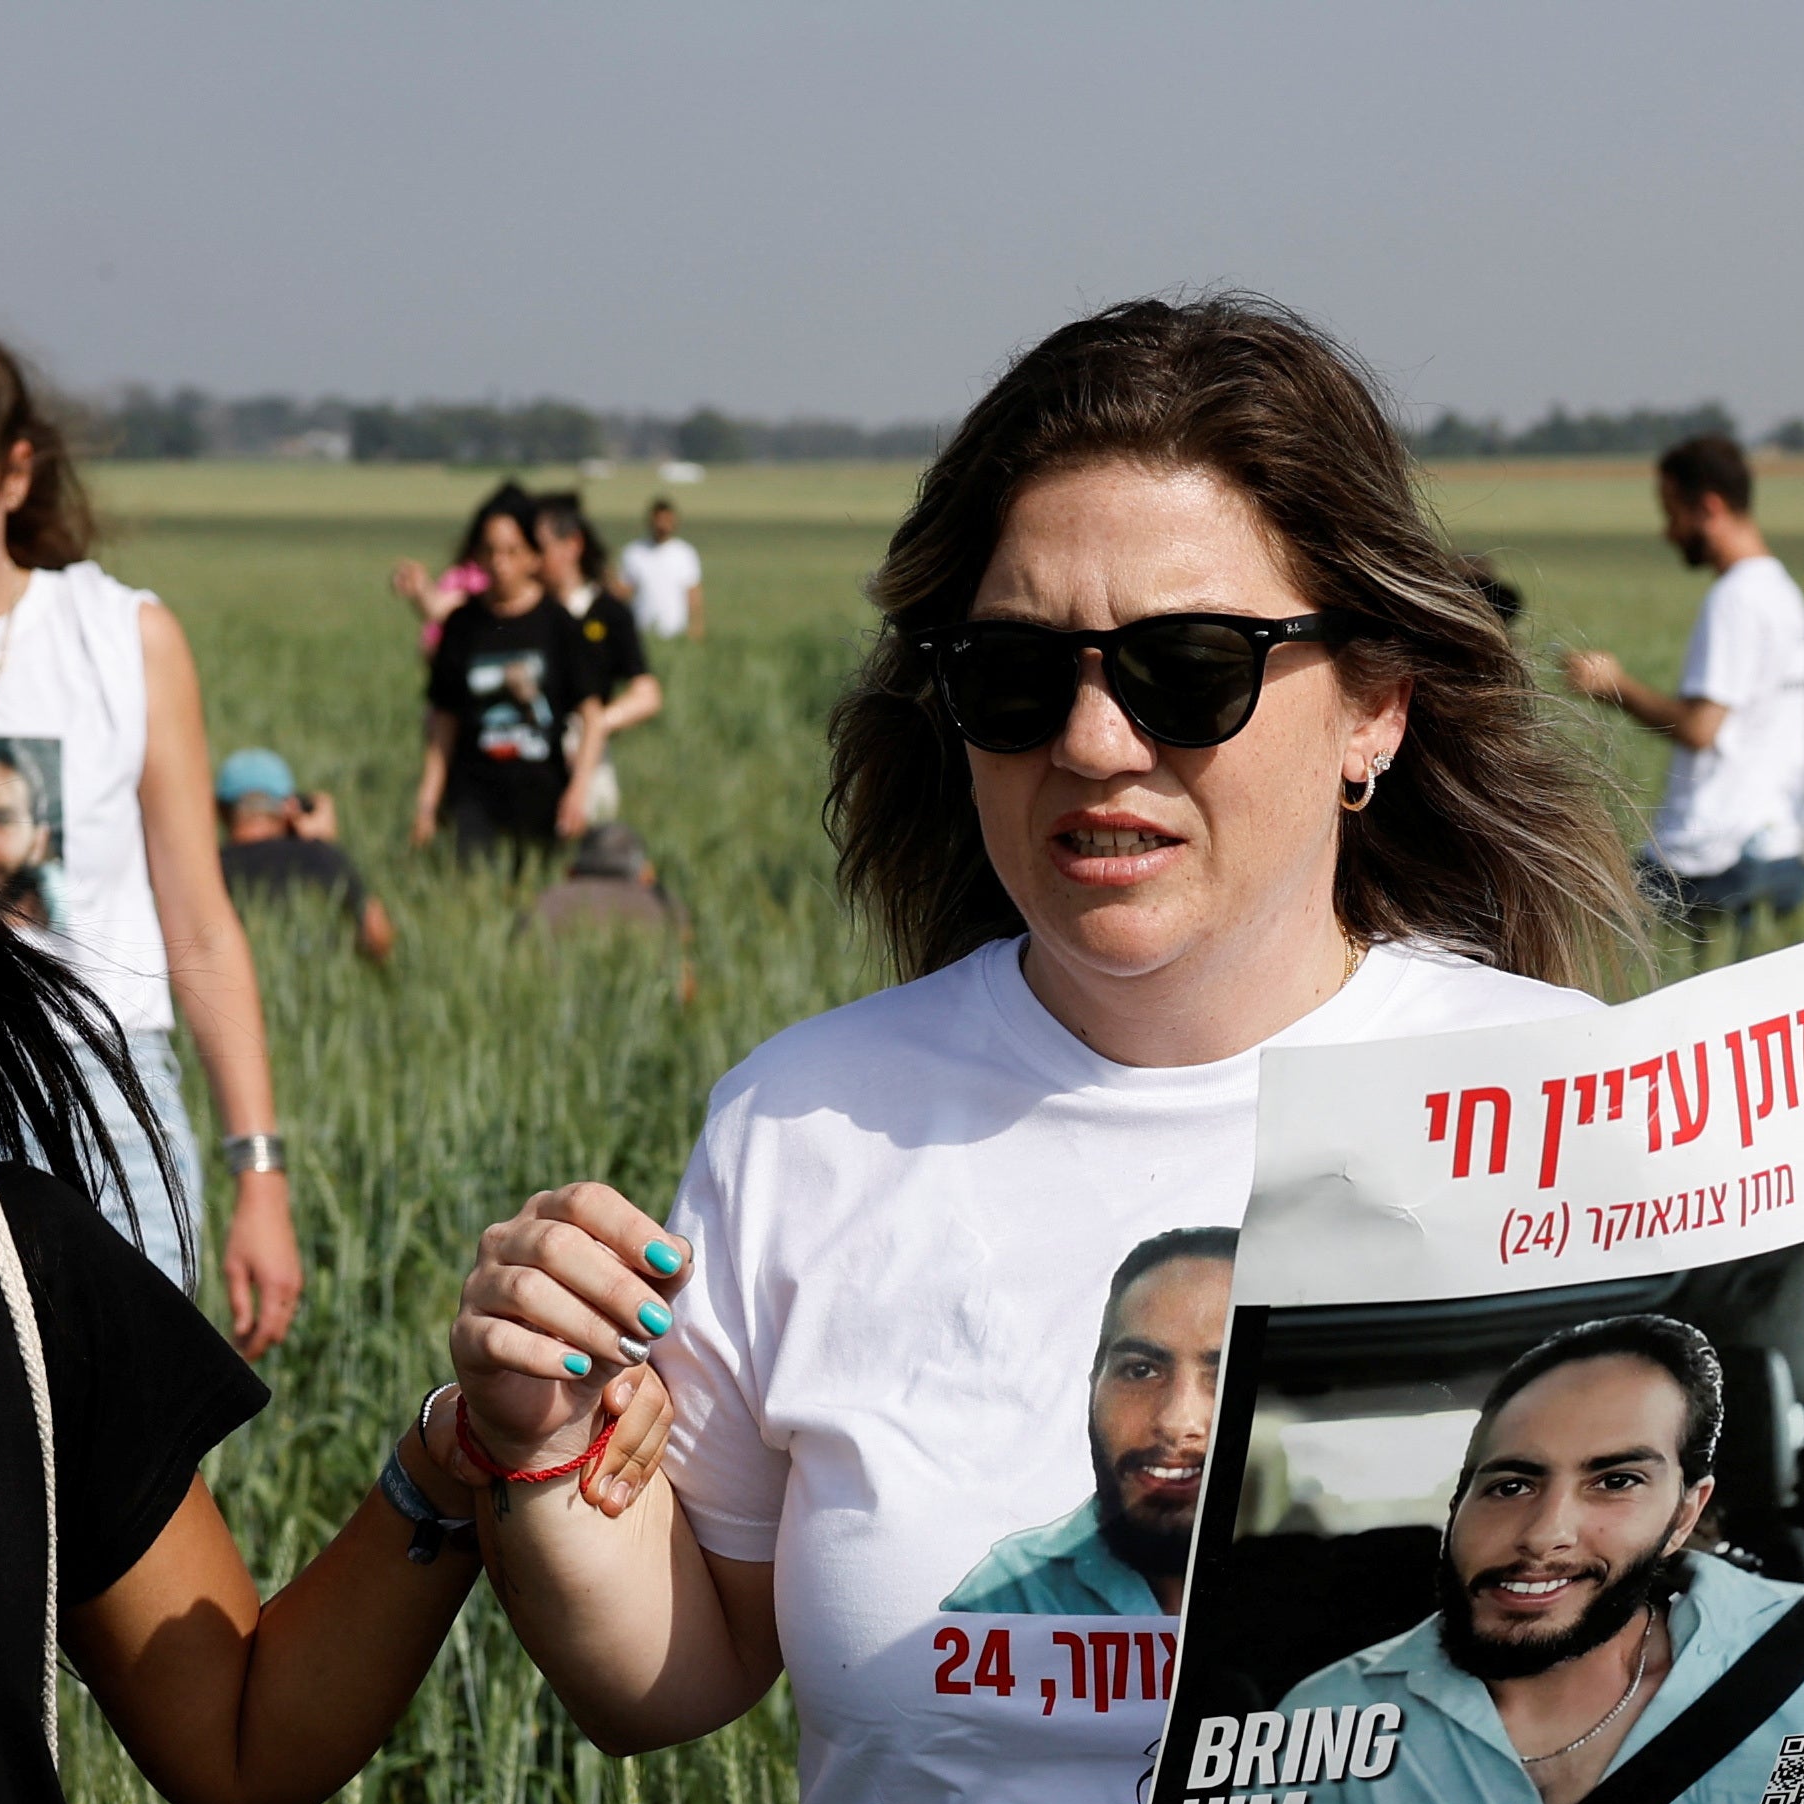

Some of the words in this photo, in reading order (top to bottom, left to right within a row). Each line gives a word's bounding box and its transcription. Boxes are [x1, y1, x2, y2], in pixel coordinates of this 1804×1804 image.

[1424, 1085, 1513, 1179] חי
[1538, 1041, 1711, 1190] עדיין
[1587, 1183, 1727, 1250] צנגאוקר
[1738, 1163, 1795, 1227] מתן
[1499, 1202, 1571, 1264] (24)
[934, 1627, 1015, 1696] 24
[1186, 1702, 1401, 1790] BRING
